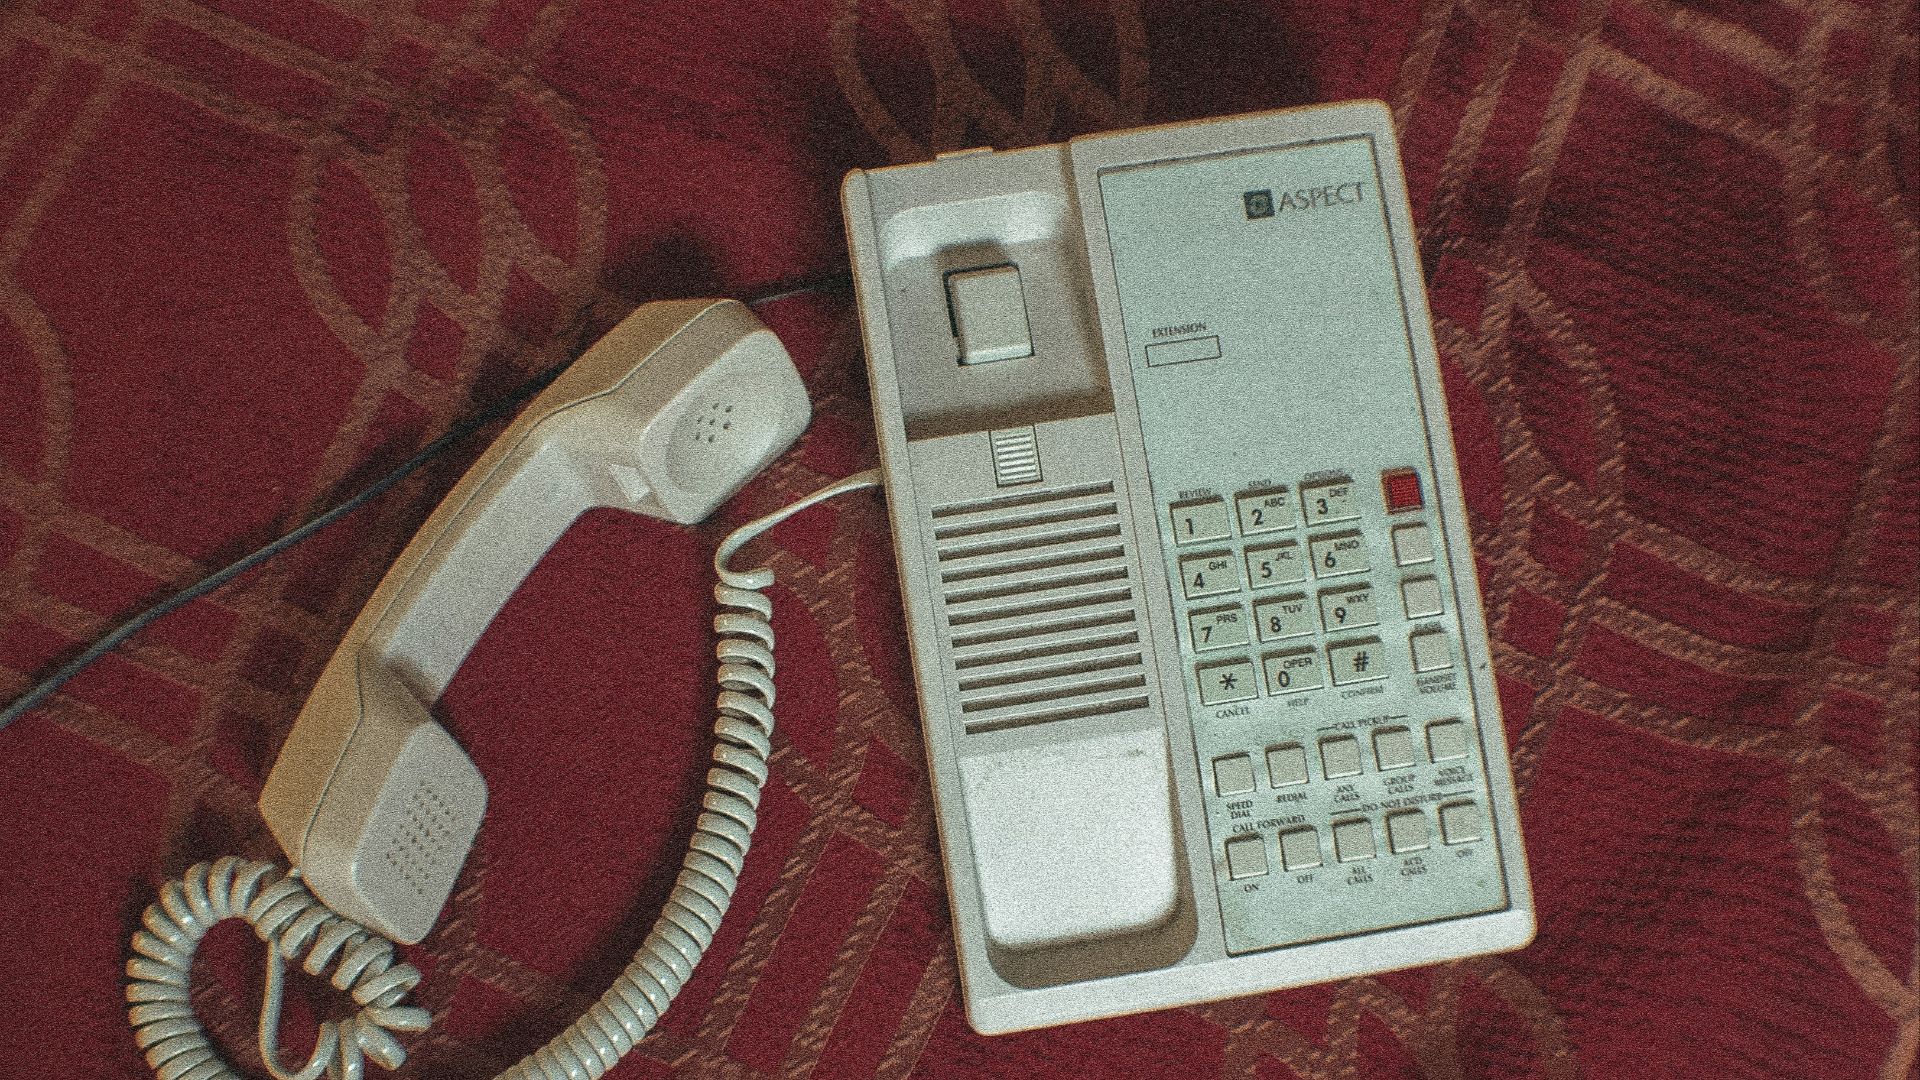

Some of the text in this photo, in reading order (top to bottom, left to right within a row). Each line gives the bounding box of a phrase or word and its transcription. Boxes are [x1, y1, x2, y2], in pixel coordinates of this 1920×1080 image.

[1279, 181, 1364, 212] ASPECT
[1152, 322, 1207, 338] EXTENSION
[1264, 497, 1285, 508] ABC
[1316, 498, 1328, 515] 3
[1251, 508, 1264, 526] 2
[1185, 518, 1194, 535] 1
[1208, 560, 1227, 571] GHI
[1324, 551, 1337, 568] 6
[1261, 561, 1273, 578] 5
[1193, 572, 1205, 589] 4
[1346, 593, 1370, 604] WXY
[1282, 604, 1302, 615] TUV
[1335, 606, 1347, 623] 9
[1215, 612, 1238, 625] PRS
[1270, 616, 1282, 633] 8
[1200, 625, 1212, 643] 7
[1283, 657, 1313, 670] OPER
[1353, 651, 1370, 672] #
[1420, 682, 1456, 695] VOLUME
[1287, 698, 1309, 707] HELP
[1215, 706, 1251, 719] CANCEL
[1334, 715, 1389, 731] CALL PICKUP
[1438, 765, 1466, 776] VOICE
[1383, 773, 1416, 786] GROUP
[1337, 785, 1355, 793] ANY
[1388, 784, 1414, 795] CALLS
[1277, 791, 1307, 803] REDIAL
[1334, 793, 1361, 803] CALLS
[1362, 792, 1443, 812] DO NOT DISTURB
[1226, 800, 1253, 810] SPEED
[1231, 810, 1251, 820] DIAL
[1233, 814, 1306, 834] CALL FORWARD
[1352, 866, 1367, 875] ALL
[1400, 865, 1428, 876] CALLS
[1297, 874, 1314, 884] OFF
[1347, 874, 1374, 886] CALLS
[1244, 883, 1259, 892] ON
